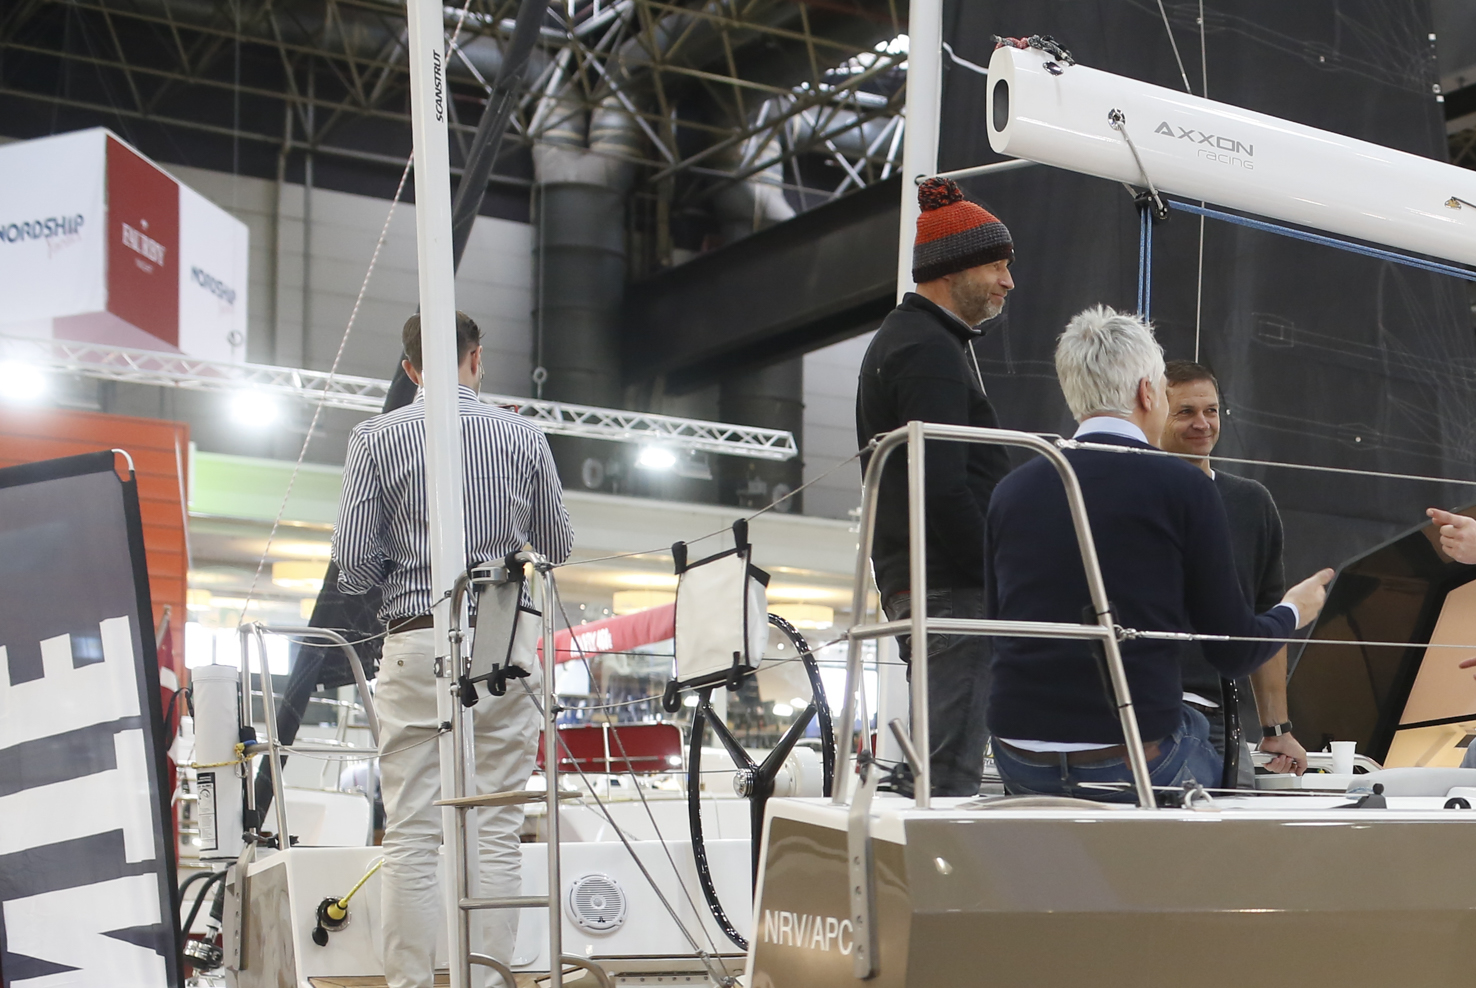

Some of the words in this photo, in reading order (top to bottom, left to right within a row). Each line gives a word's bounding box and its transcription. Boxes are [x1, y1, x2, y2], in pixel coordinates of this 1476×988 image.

[432, 48, 444, 123] SCANSTRUT
[1154, 121, 1254, 157] AXXON
[1197, 149, 1254, 170] racing
[764, 909, 854, 956] NRV/APC
